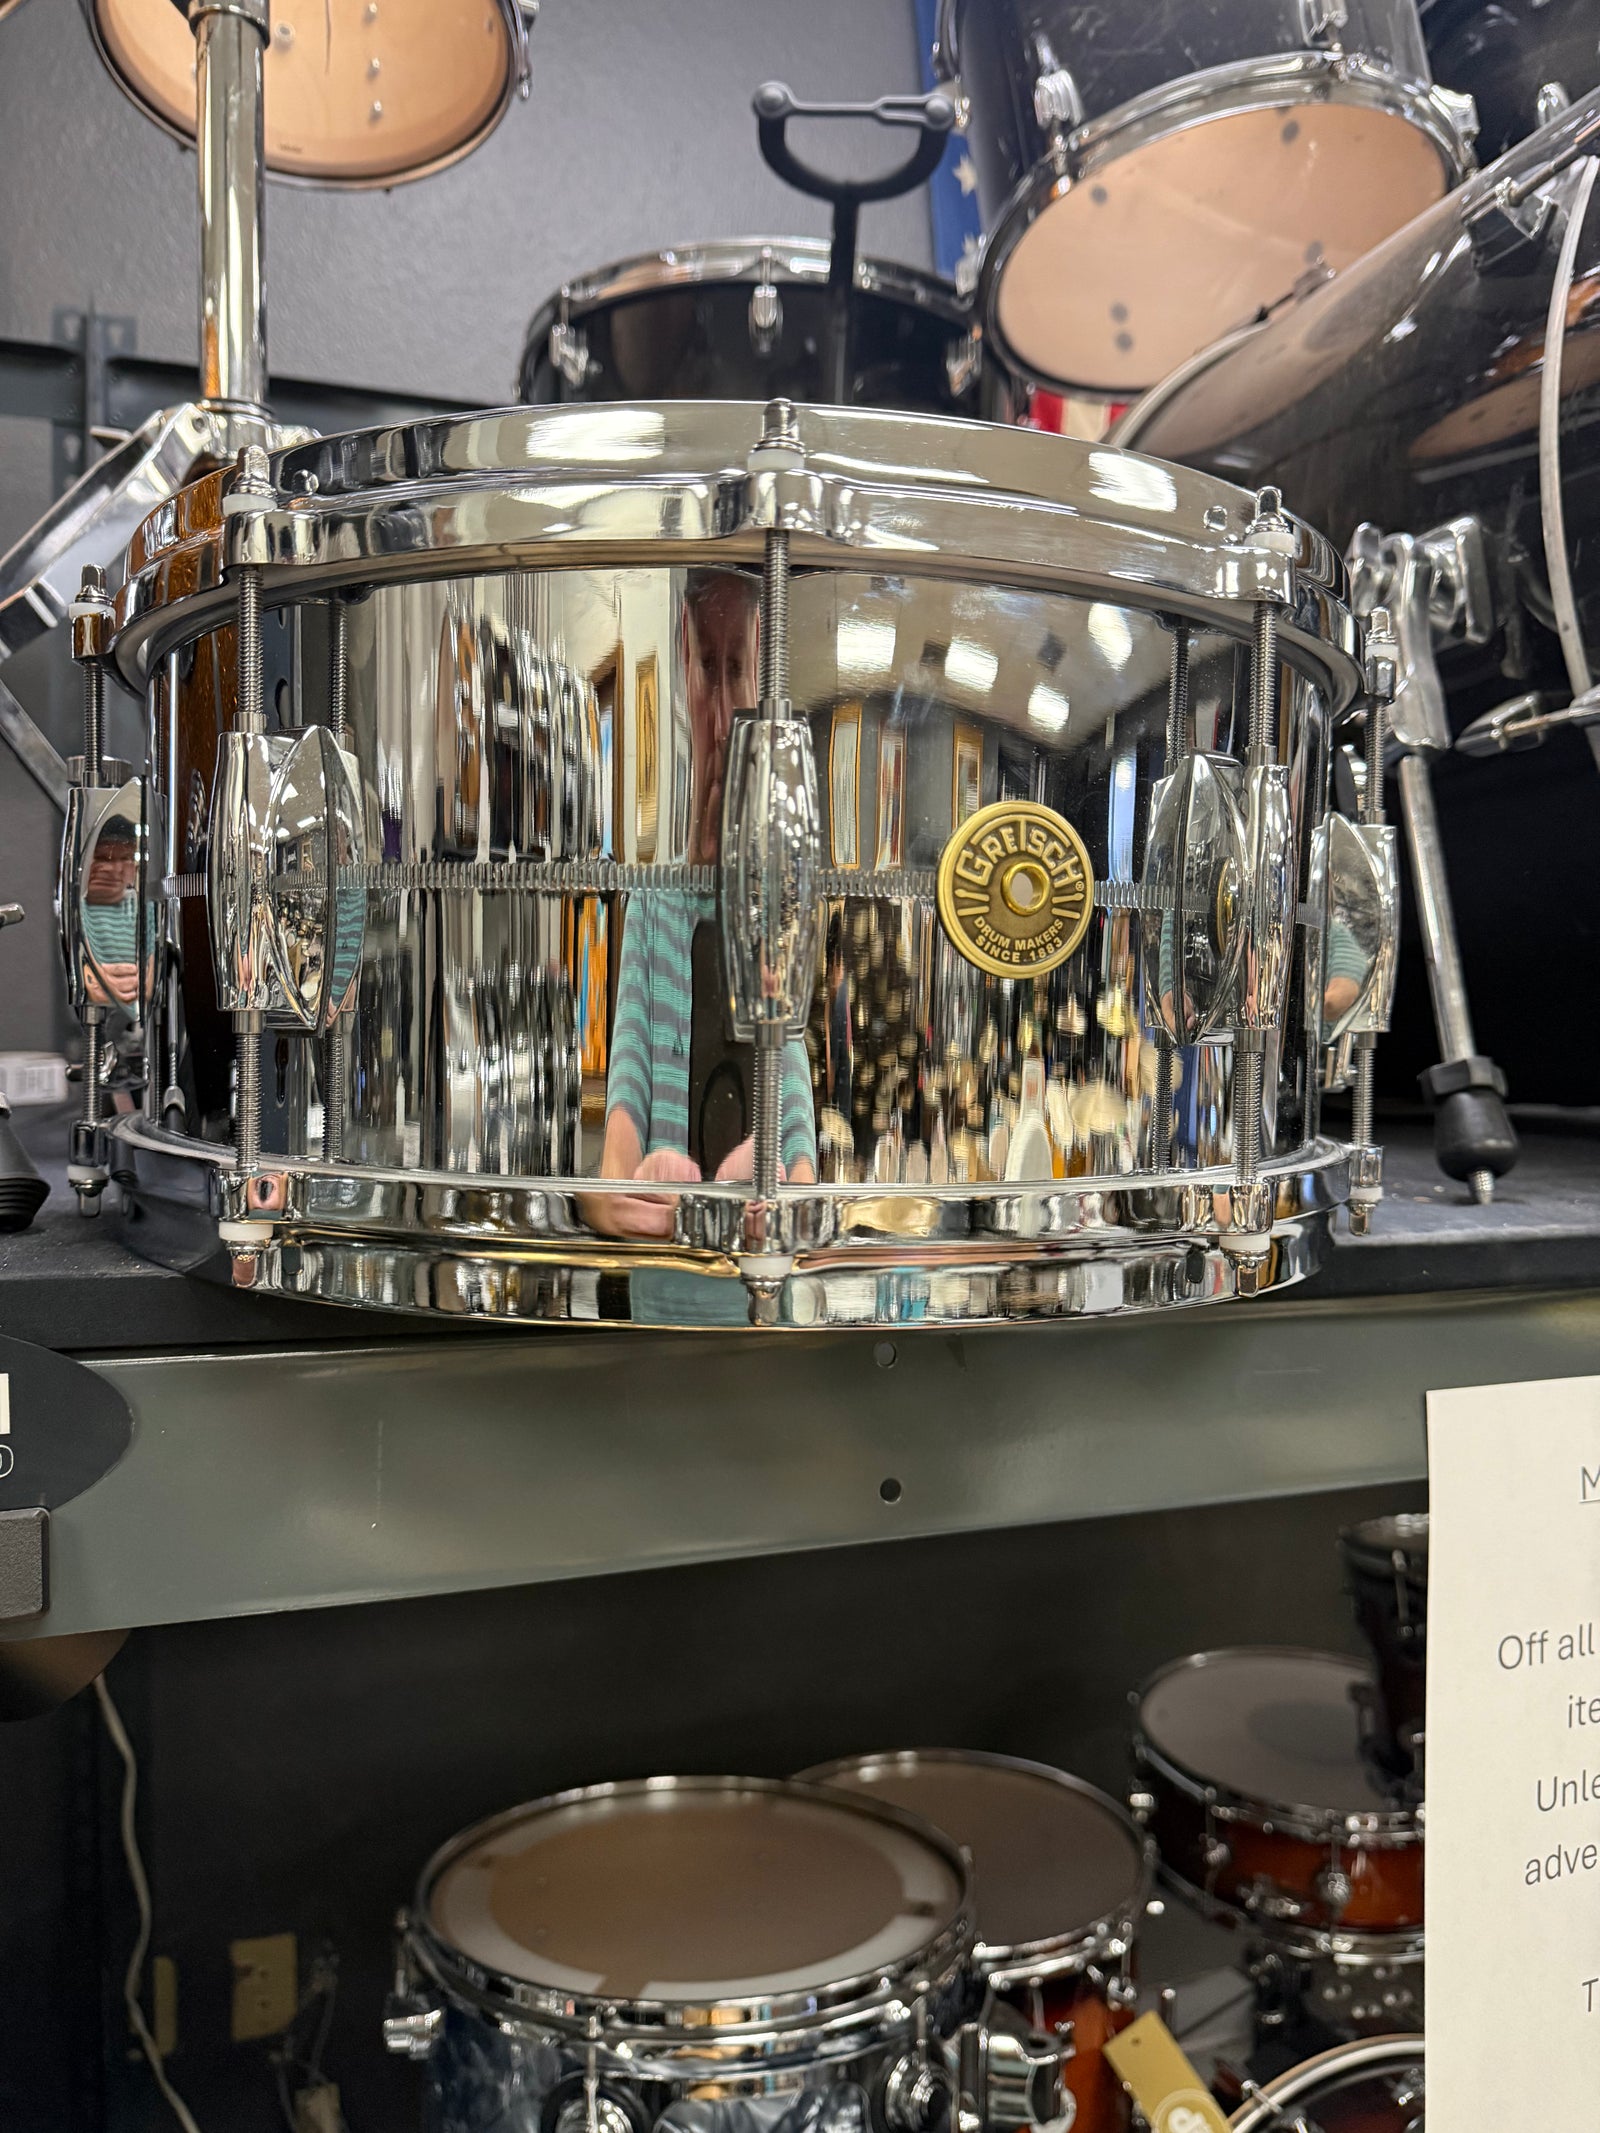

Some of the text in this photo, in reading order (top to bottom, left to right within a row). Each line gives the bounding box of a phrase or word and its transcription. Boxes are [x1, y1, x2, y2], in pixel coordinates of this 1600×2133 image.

[974, 916, 1064, 951] DRUM MAKERS
[975, 934, 1063, 963] SINCE 1883
[1498, 1622, 1594, 1670] Off all
[1568, 1694, 1600, 1728] ite
[1537, 1769, 1600, 1812] Unle
[1525, 1844, 1598, 1885] adve
[1582, 1977, 1599, 2012] T
